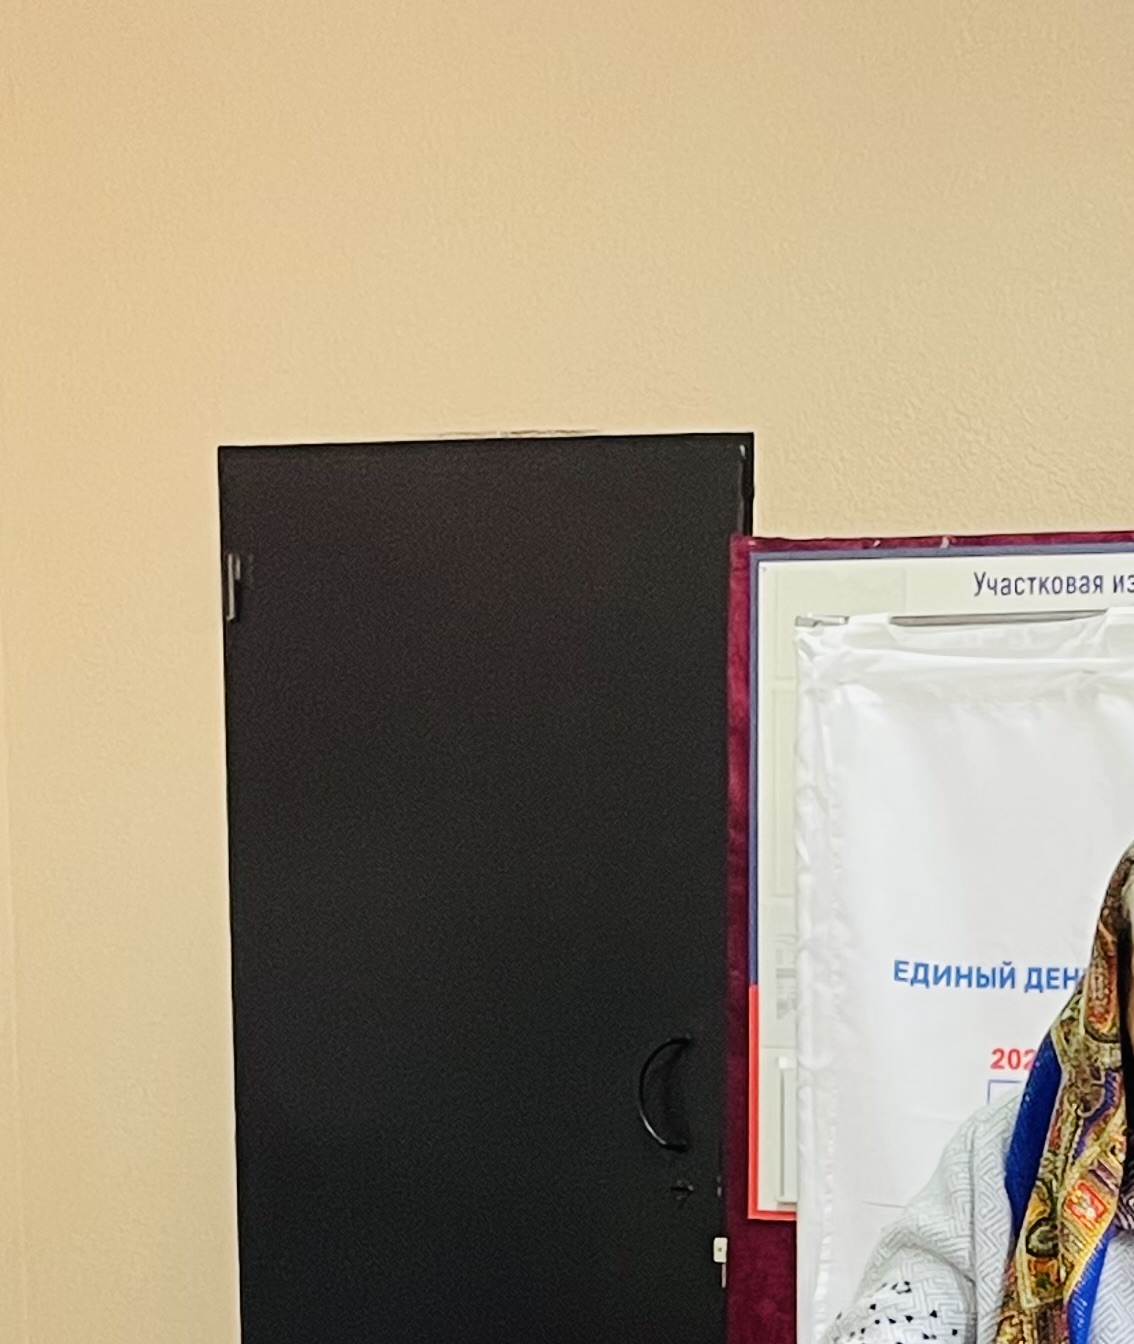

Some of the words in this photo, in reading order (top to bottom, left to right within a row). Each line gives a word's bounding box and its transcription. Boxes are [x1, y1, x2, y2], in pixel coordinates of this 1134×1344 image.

[973, 571, 1103, 597] Участковая
[893, 960, 1016, 989] ЕДИНЫЙ
[1024, 966, 1083, 992] ДЕН
[990, 1047, 1035, 1071] 202
